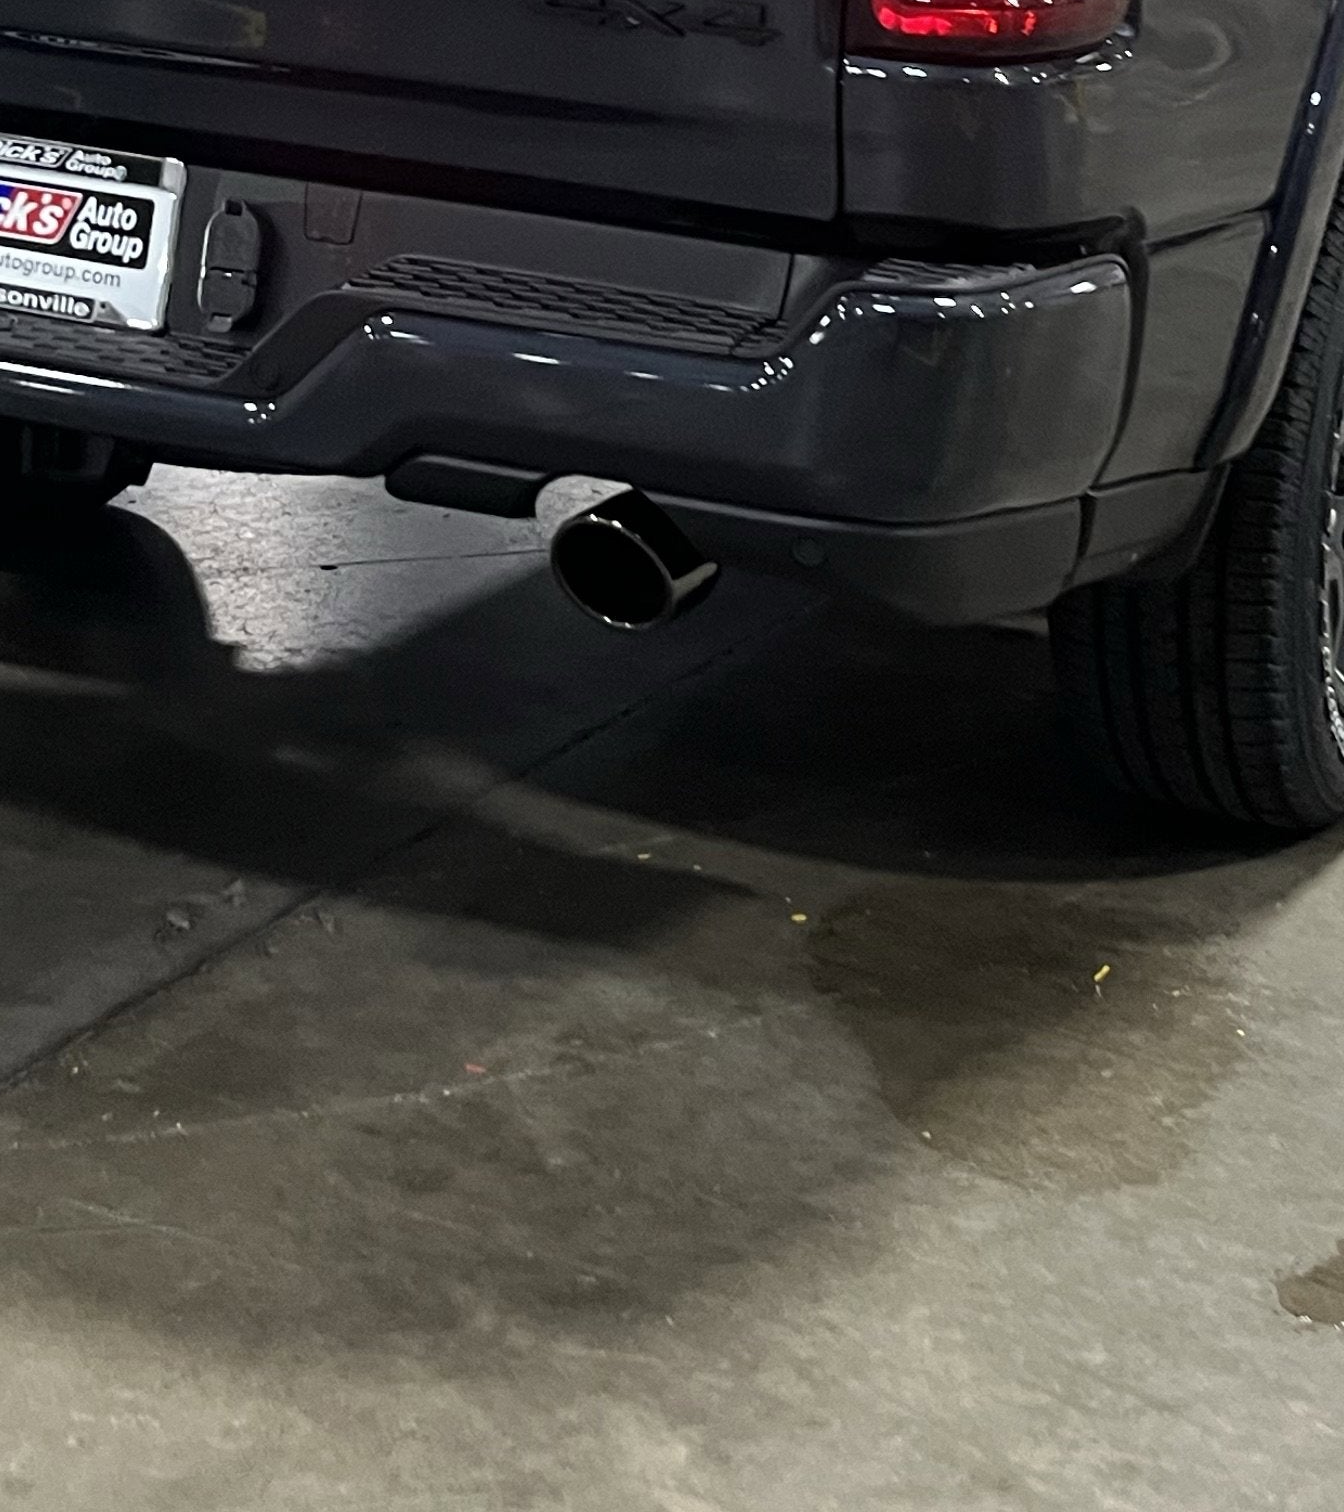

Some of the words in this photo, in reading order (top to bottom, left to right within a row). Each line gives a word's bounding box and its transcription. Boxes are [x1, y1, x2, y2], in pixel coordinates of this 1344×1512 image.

[65, 159, 121, 182] Group
[74, 149, 112, 166] Auto
[76, 196, 138, 231] Auto
[69, 220, 144, 264] Group
